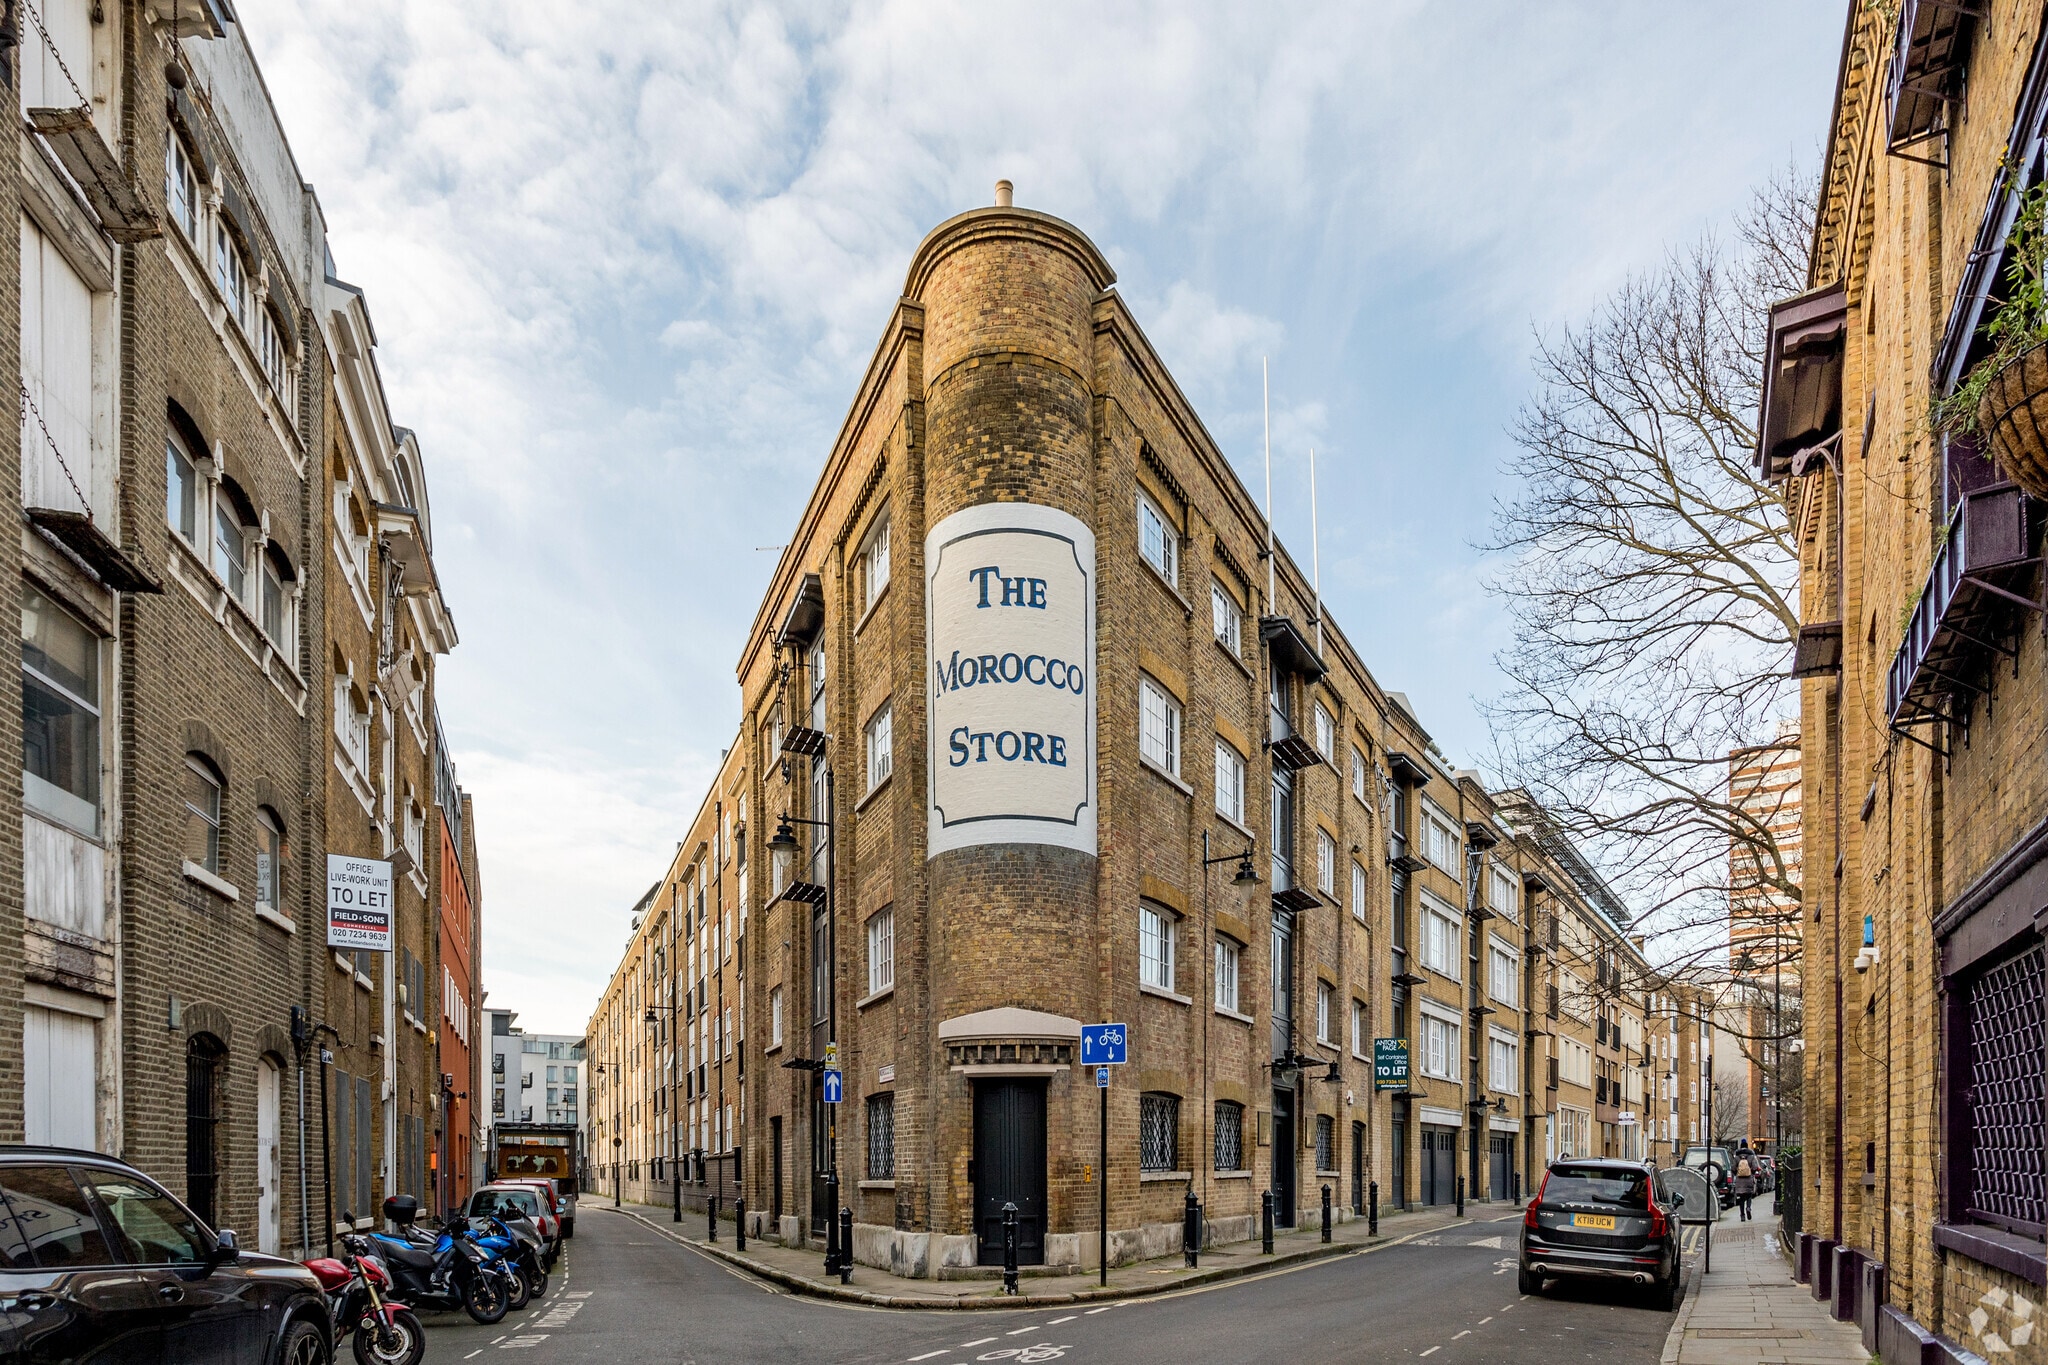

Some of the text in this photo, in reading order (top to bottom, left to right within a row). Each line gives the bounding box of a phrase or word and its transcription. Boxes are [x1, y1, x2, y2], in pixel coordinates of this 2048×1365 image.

[969, 566, 1047, 609] THE
[936, 650, 1083, 698] MOROCCO
[949, 726, 1067, 767] STORE
[346, 862, 374, 873] OFFICE/
[331, 873, 388, 887] LIVE-WORK UNIT
[332, 887, 387, 907] TO LET
[335, 912, 358, 921] FIELD
[363, 915, 385, 924] SONS
[333, 928, 387, 941] 020 7234 9639
[1377, 1066, 1407, 1076] TO LET
[1576, 1214, 1612, 1227] KT18 UCW
